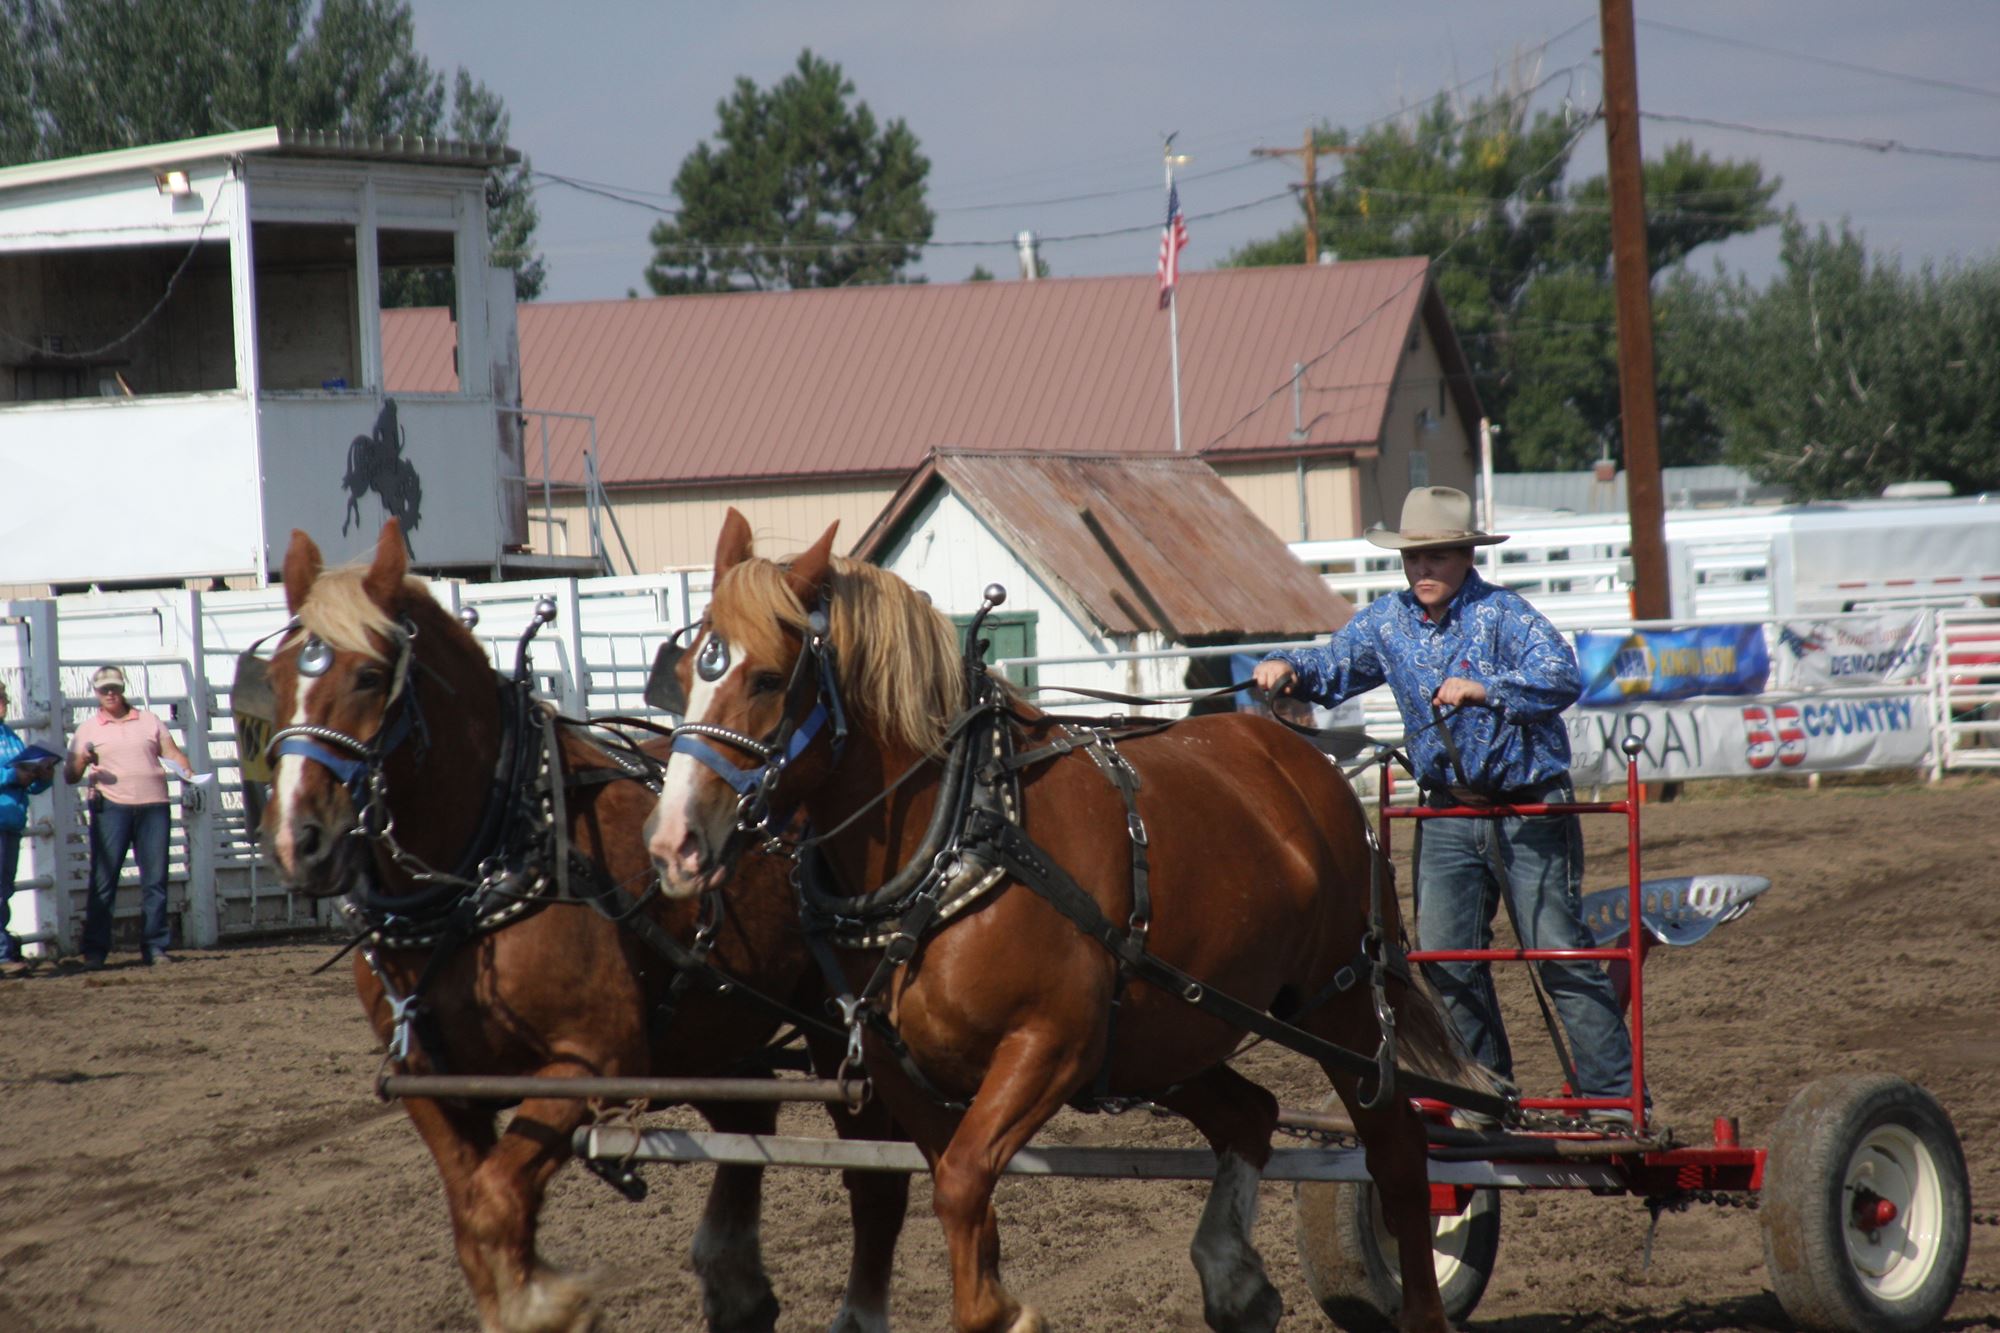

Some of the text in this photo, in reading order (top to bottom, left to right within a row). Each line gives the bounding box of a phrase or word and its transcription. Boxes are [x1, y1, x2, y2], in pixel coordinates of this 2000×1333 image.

[1660, 646, 1737, 677] KNOW HOW
[1596, 711, 1702, 771] KRAI
[1743, 704, 1806, 769] 55
[1803, 698, 1912, 737] COUNTRY
